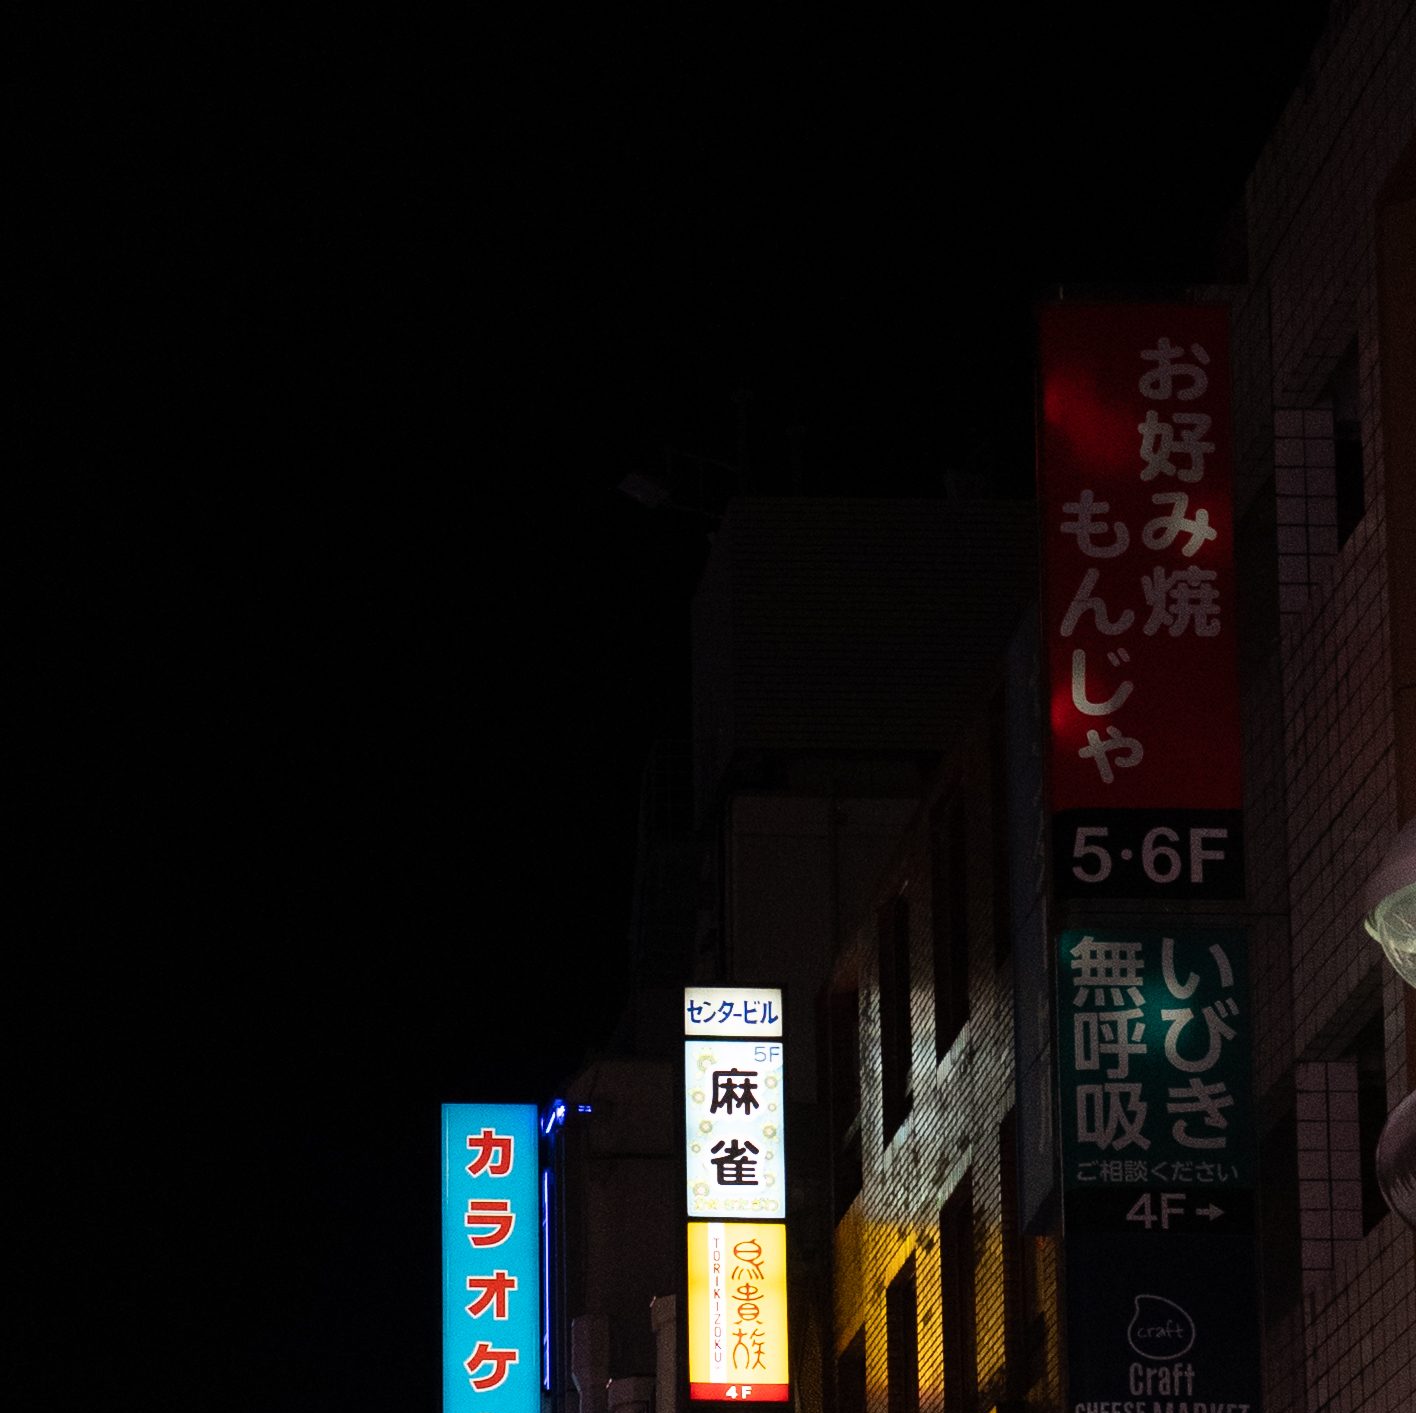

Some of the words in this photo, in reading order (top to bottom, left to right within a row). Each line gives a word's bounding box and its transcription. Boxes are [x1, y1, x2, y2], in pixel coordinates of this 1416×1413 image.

[1137, 335, 1221, 639] お好み焼
[1059, 488, 1145, 785] もんじゃ
[686, 999, 780, 1025] センタービル
[753, 1046, 781, 1063] 5F
[1068, 935, 1151, 1153] 無呼吸
[1160, 937, 1240, 1151] いびき
[709, 1066, 760, 1188] 麻雀
[1075, 1160, 1239, 1184] ご相談ください
[1125, 1193, 1187, 1230] 4F
[713, 1237, 723, 1363] TORIKIZOKU
[1136, 1318, 1184, 1339] craft
[725, 1385, 753, 1399] 4F
[1128, 1361, 1196, 1397] Craft
